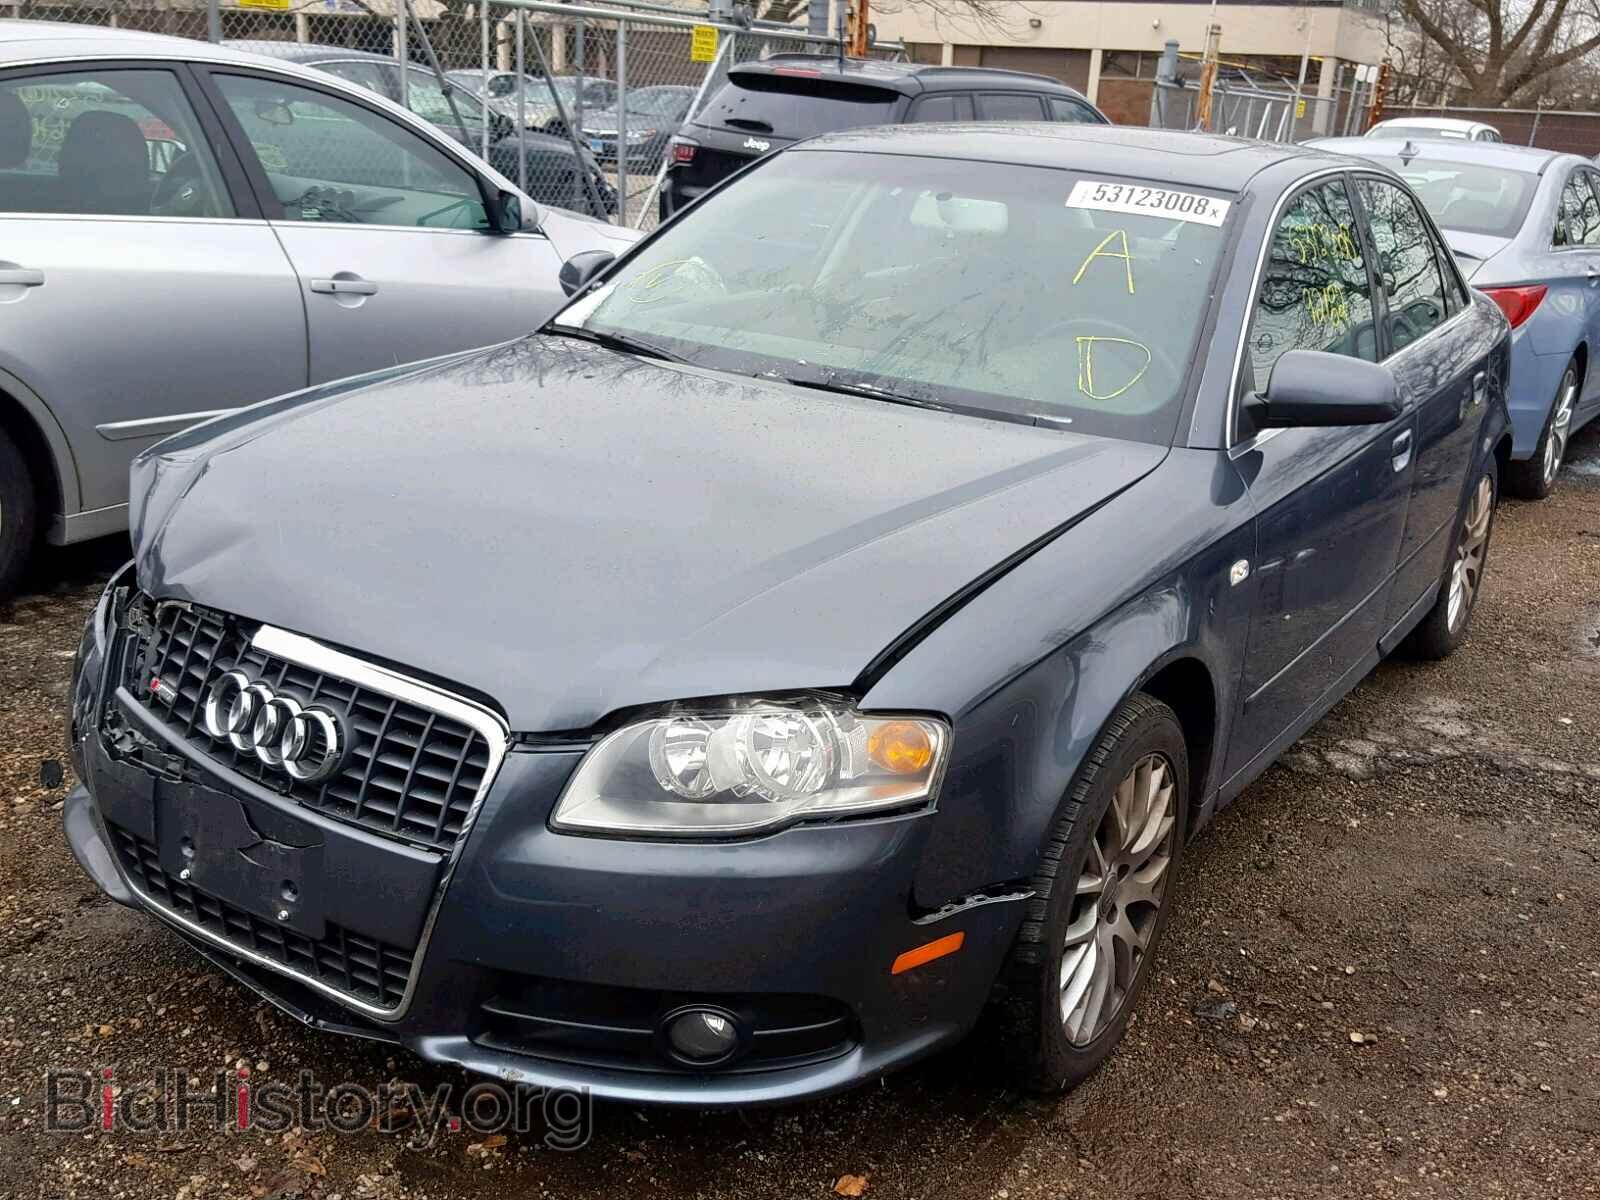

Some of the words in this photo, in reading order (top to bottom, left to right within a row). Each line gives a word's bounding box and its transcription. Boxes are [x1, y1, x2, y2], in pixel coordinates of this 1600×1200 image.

[743, 137, 770, 151] Jeep
[1092, 184, 1210, 216] 53123008
[1073, 230, 1136, 295] A
[1076, 336, 1151, 400] D
